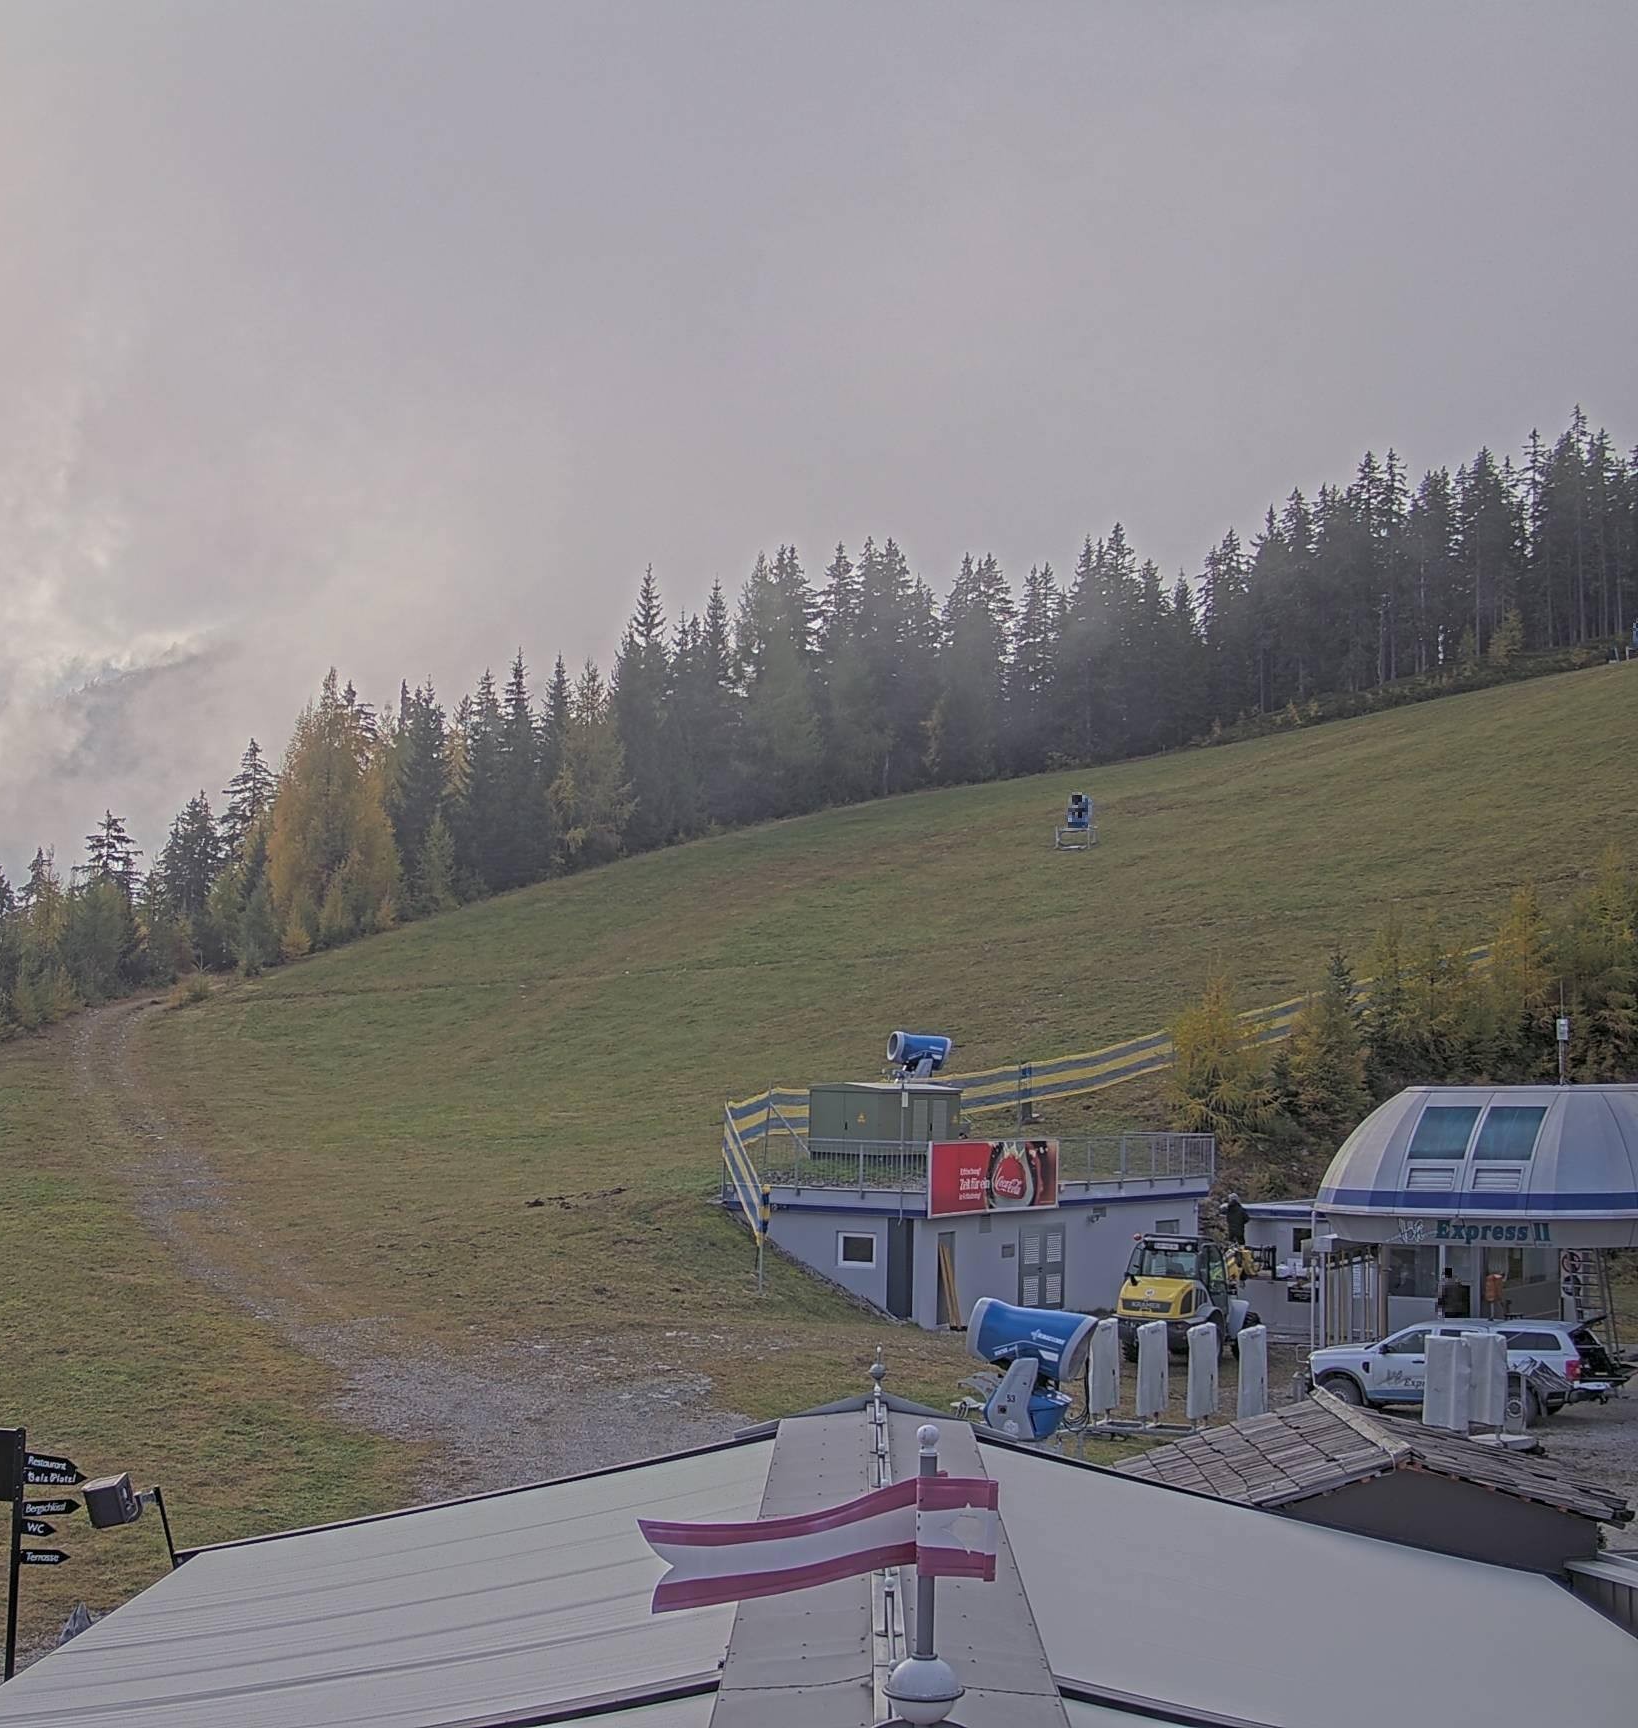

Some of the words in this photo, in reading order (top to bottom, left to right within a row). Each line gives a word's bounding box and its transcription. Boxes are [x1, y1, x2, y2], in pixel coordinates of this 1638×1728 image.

[1436, 1219, 1529, 1245] Express
[1532, 1222, 1551, 1242] II
[1131, 1301, 1161, 1310] KRAMER
[1006, 1394, 1016, 1403] 53
[27, 1455, 67, 1471] Restaurant
[27, 1522, 45, 1534] WC
[26, 1551, 60, 1562] Terrasse
